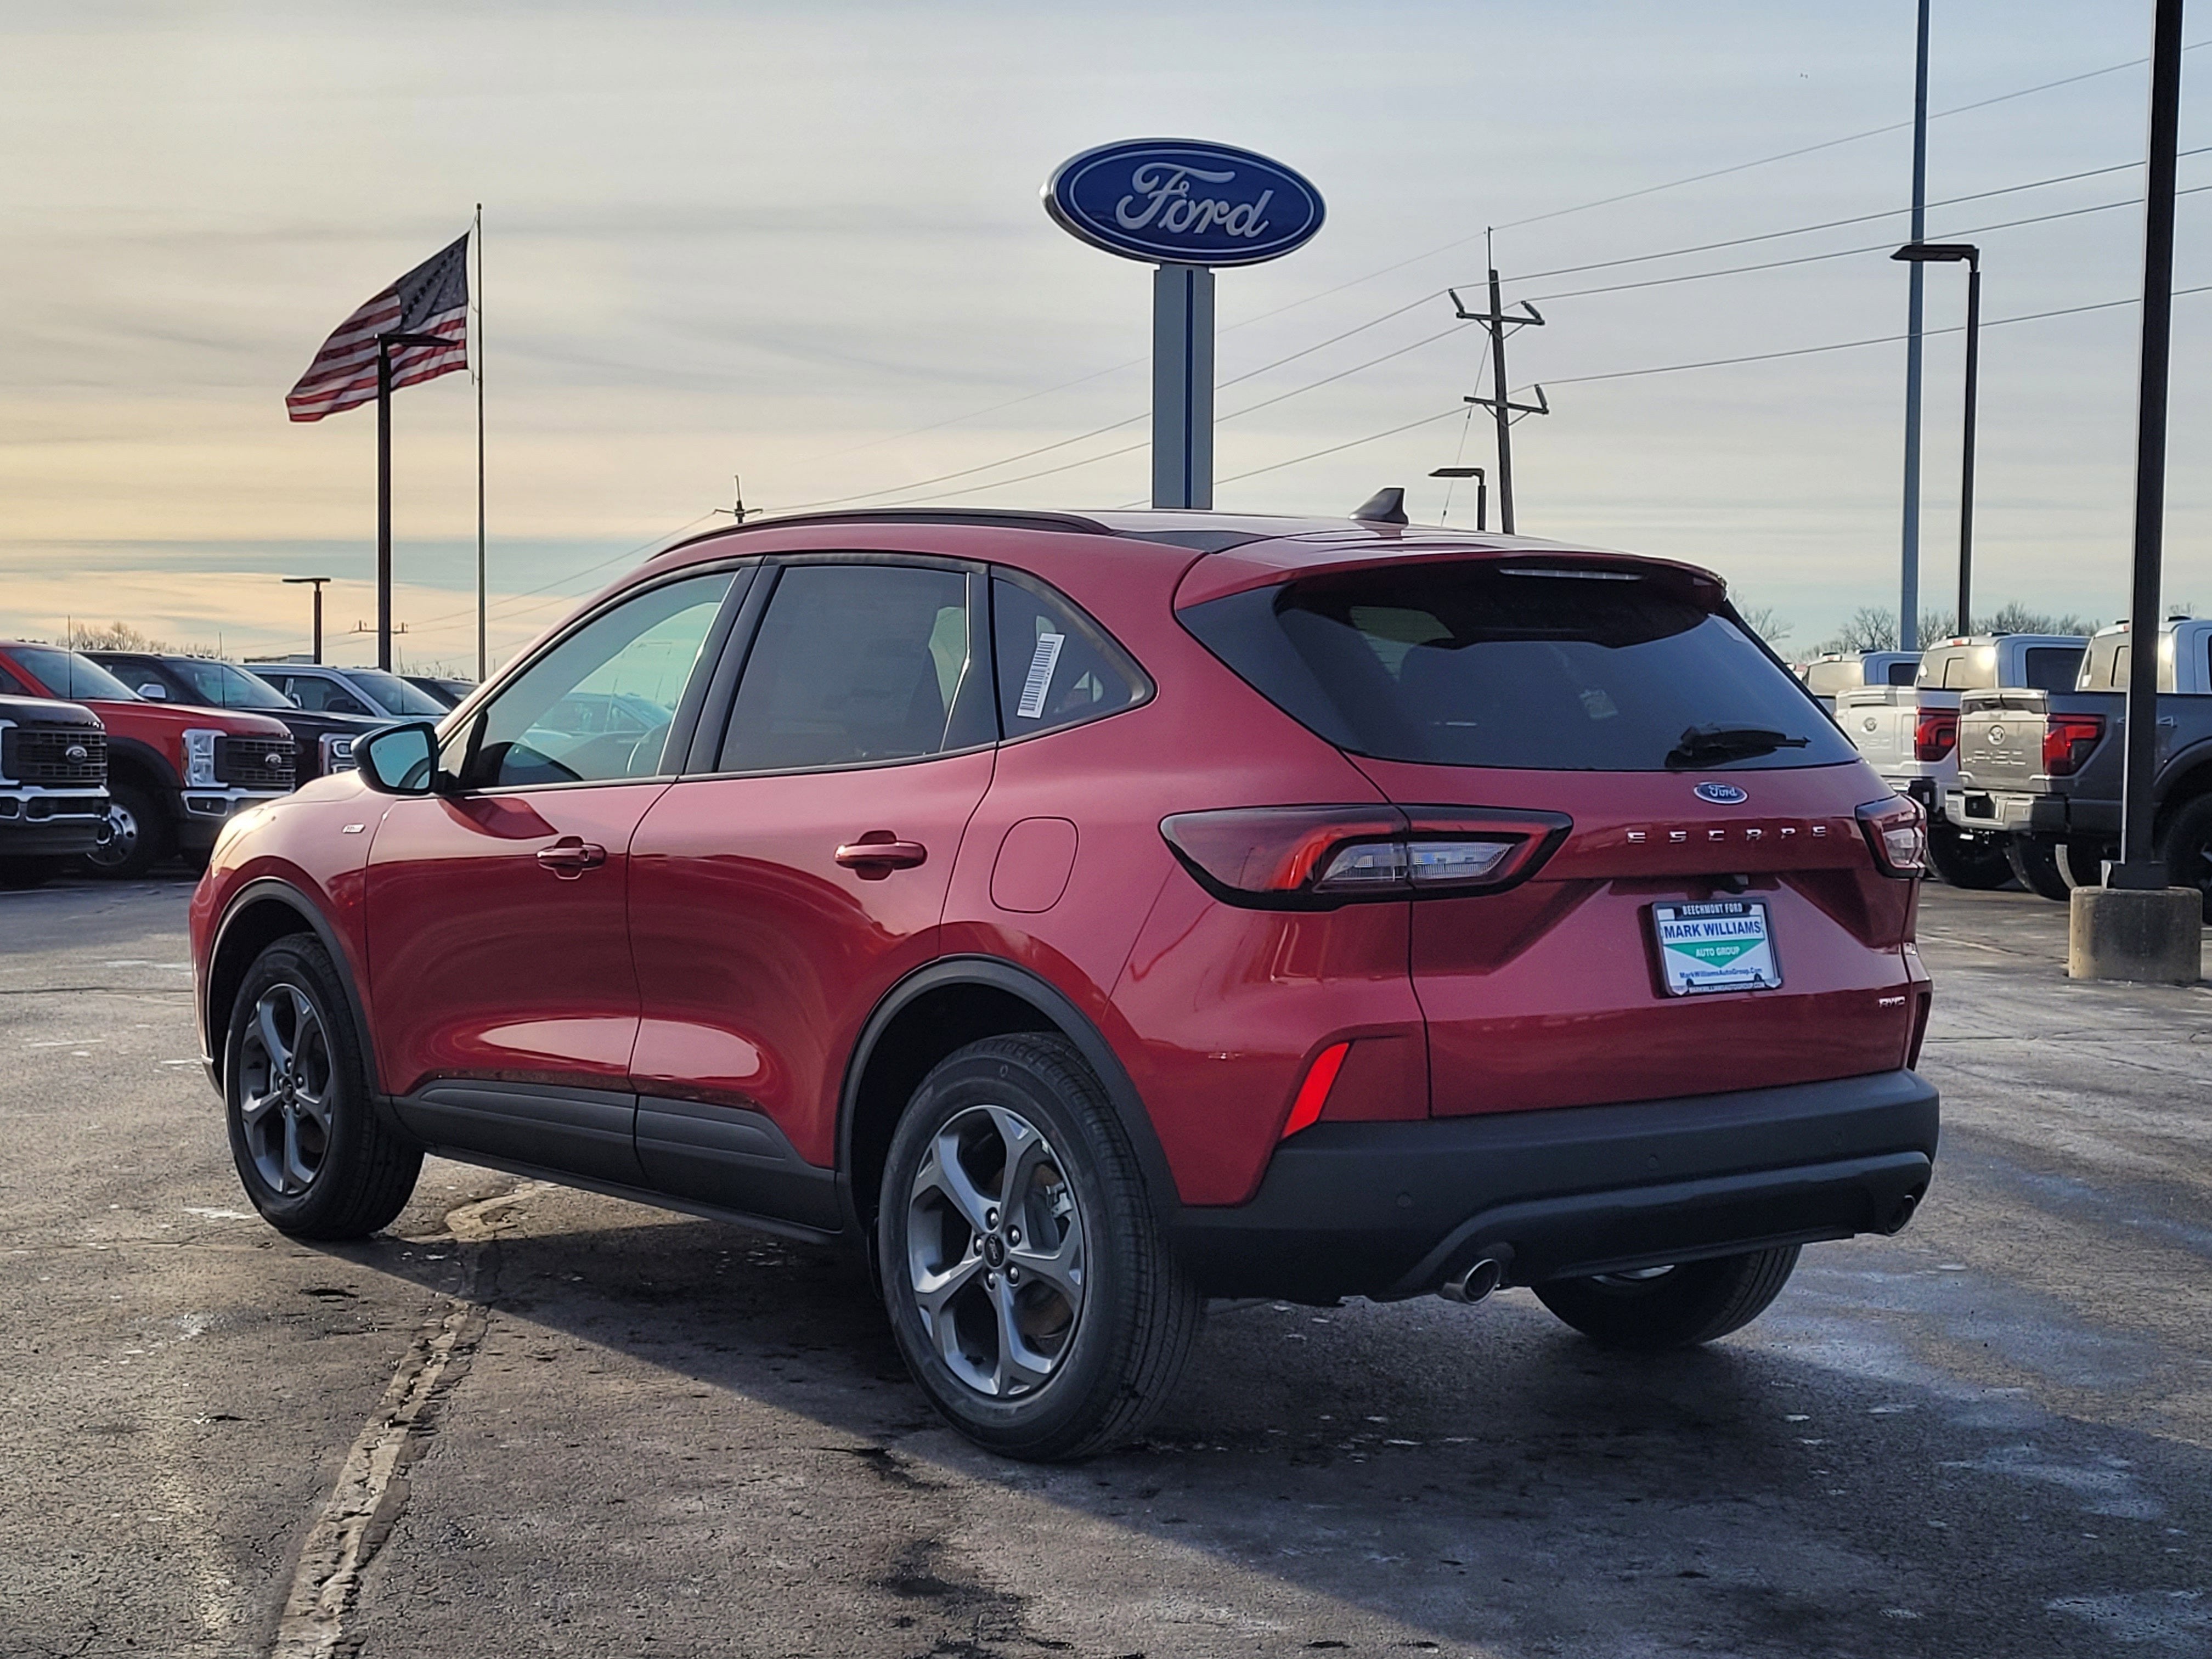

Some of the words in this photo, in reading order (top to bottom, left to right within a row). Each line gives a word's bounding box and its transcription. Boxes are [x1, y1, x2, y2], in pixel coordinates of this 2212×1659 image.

[1115, 162, 1274, 238] Ford
[1708, 784, 1738, 797] Ford
[1627, 826, 1826, 843] ESCAPE
[1683, 904, 1724, 915] BEECHMONT
[1725, 902, 1743, 913] FORD
[1664, 924, 1701, 939] MARK
[1703, 921, 1762, 936] WILLIAMS
[1695, 948, 1715, 957] AUTO
[1716, 946, 1740, 956] GROUP
